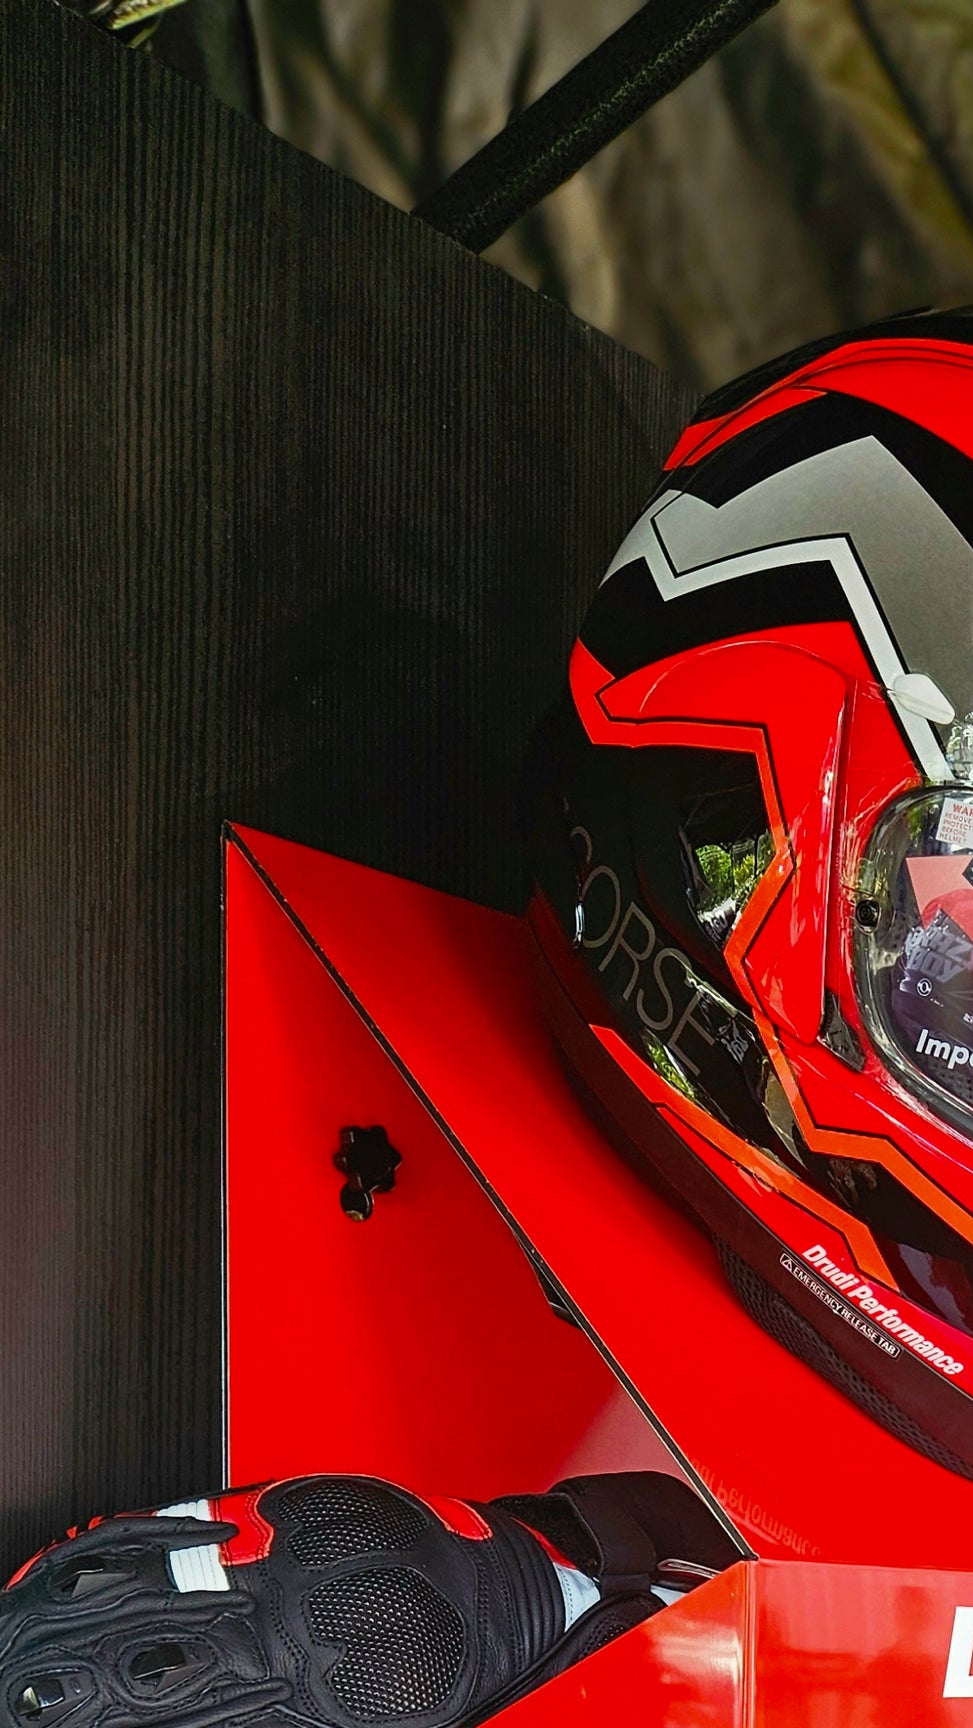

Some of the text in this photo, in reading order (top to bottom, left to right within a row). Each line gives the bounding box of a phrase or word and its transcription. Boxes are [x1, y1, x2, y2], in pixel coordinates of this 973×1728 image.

[944, 812, 972, 824] REMOVE
[939, 832, 967, 844] HELMET
[942, 826, 967, 838] BEFORE
[793, 1266, 897, 1356] EMERGENCY RELEASE TAB
[802, 1244, 964, 1375] Drudi Performance
